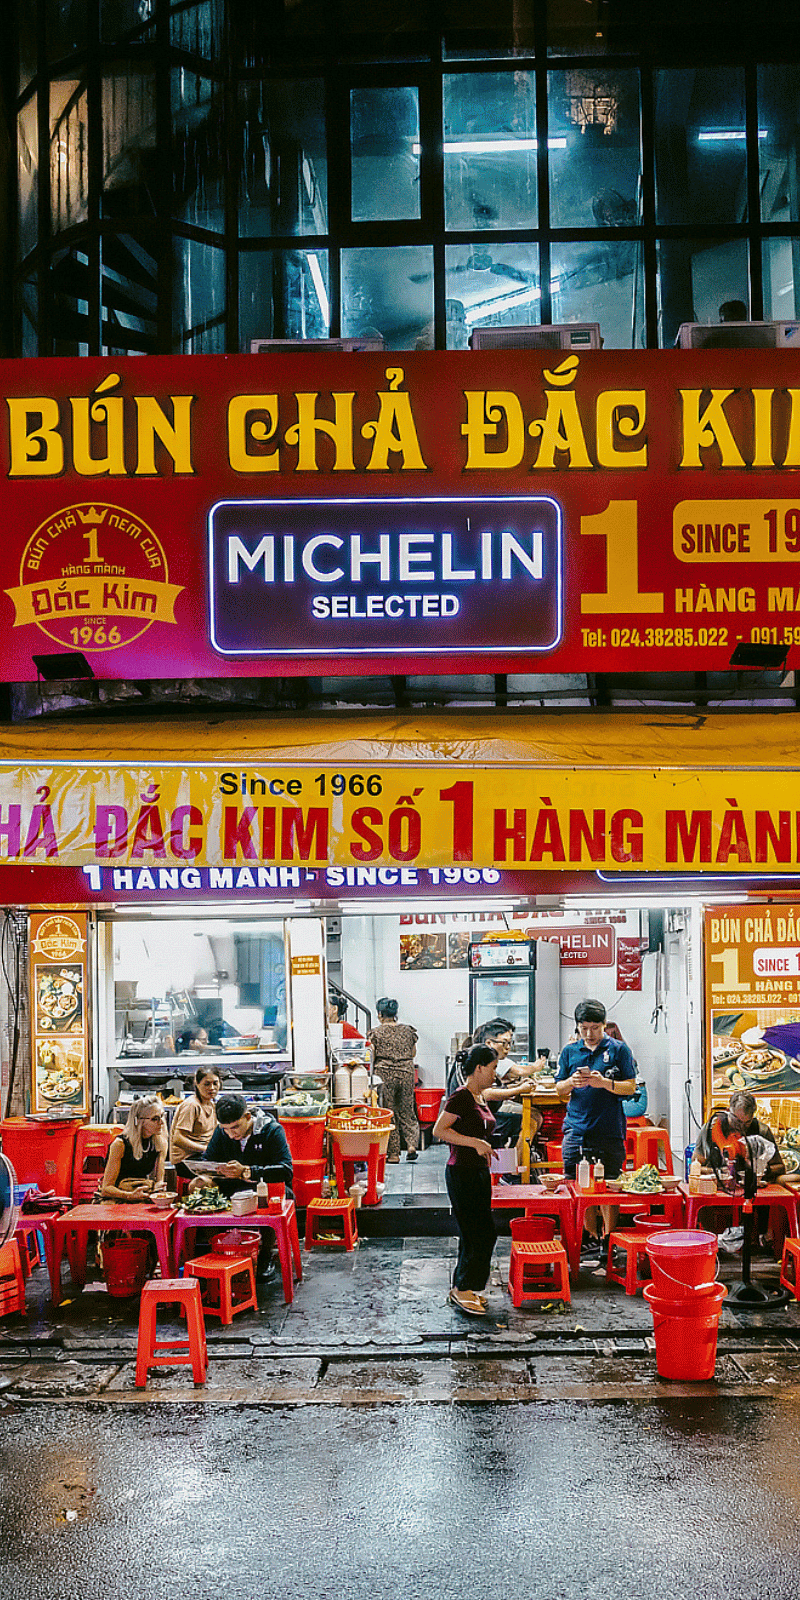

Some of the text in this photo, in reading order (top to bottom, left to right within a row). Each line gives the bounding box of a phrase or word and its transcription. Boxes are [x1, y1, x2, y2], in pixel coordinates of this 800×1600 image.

[6, 354, 800, 476] BÚN CHẢ ĐẮC KI
[27, 510, 162, 570] BÚN CHẢ NEM CUA
[83, 528, 104, 563] 1
[681, 524, 750, 553] SINCE
[61, 562, 126, 576] HÀNG MÀNH
[228, 532, 543, 583] MICHELIN
[580, 500, 664, 614] 1
[31, 581, 157, 616] Đắc Kim
[312, 594, 460, 618] SELECTED
[675, 583, 800, 613] HÀNG M
[83, 617, 106, 625] SINCE
[70, 626, 121, 645] 1966
[581, 628, 607, 647] Tel:
[611, 628, 728, 647] 024.38285.022
[219, 773, 383, 796] Since 1966
[94, 784, 203, 859] ĐẮC
[224, 806, 328, 861] KIM
[350, 787, 424, 861] SỐ
[440, 781, 474, 862] 1
[494, 797, 643, 862] HÀNG
[666, 798, 800, 863] MÀN
[83, 865, 102, 890] 1
[326, 867, 418, 886] SINCE
[428, 867, 499, 885] 1966
[711, 914, 741, 943] BÚN
[744, 909, 774, 943] CHẢ
[560, 951, 588, 959] LECTED
[757, 958, 790, 972] SINCE
[711, 948, 750, 992] 1
[755, 979, 793, 991] HÀNG
[711, 994, 726, 1004] Tel:
